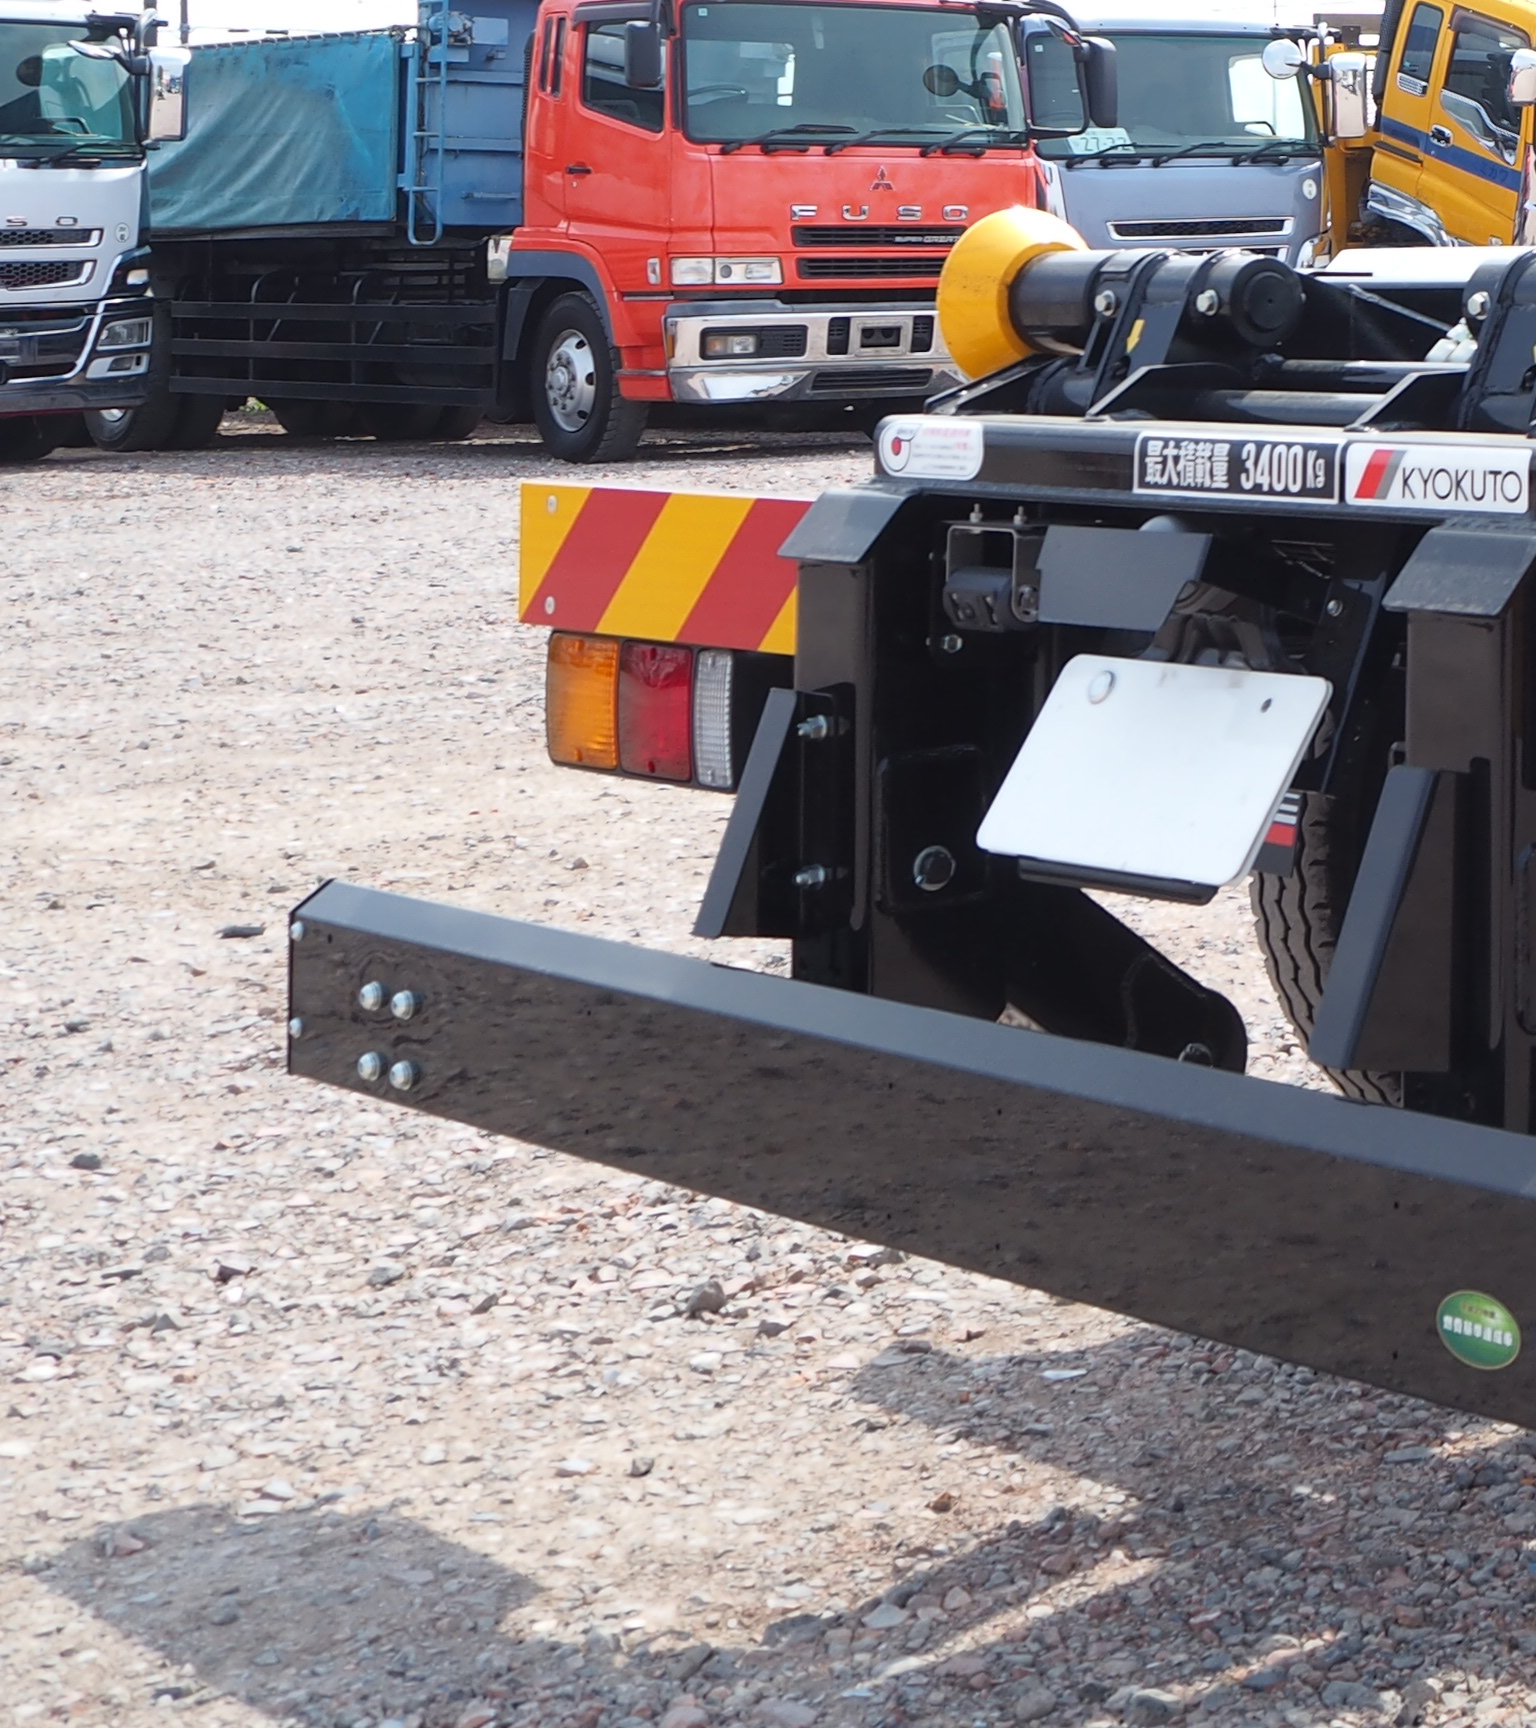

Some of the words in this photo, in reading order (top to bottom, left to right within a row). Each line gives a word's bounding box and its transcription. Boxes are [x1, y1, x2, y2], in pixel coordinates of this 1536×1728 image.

[790, 204, 969, 221] FUSO
[1145, 439, 1231, 489] 最大積載量
[1401, 466, 1523, 503] KYOKUTO
